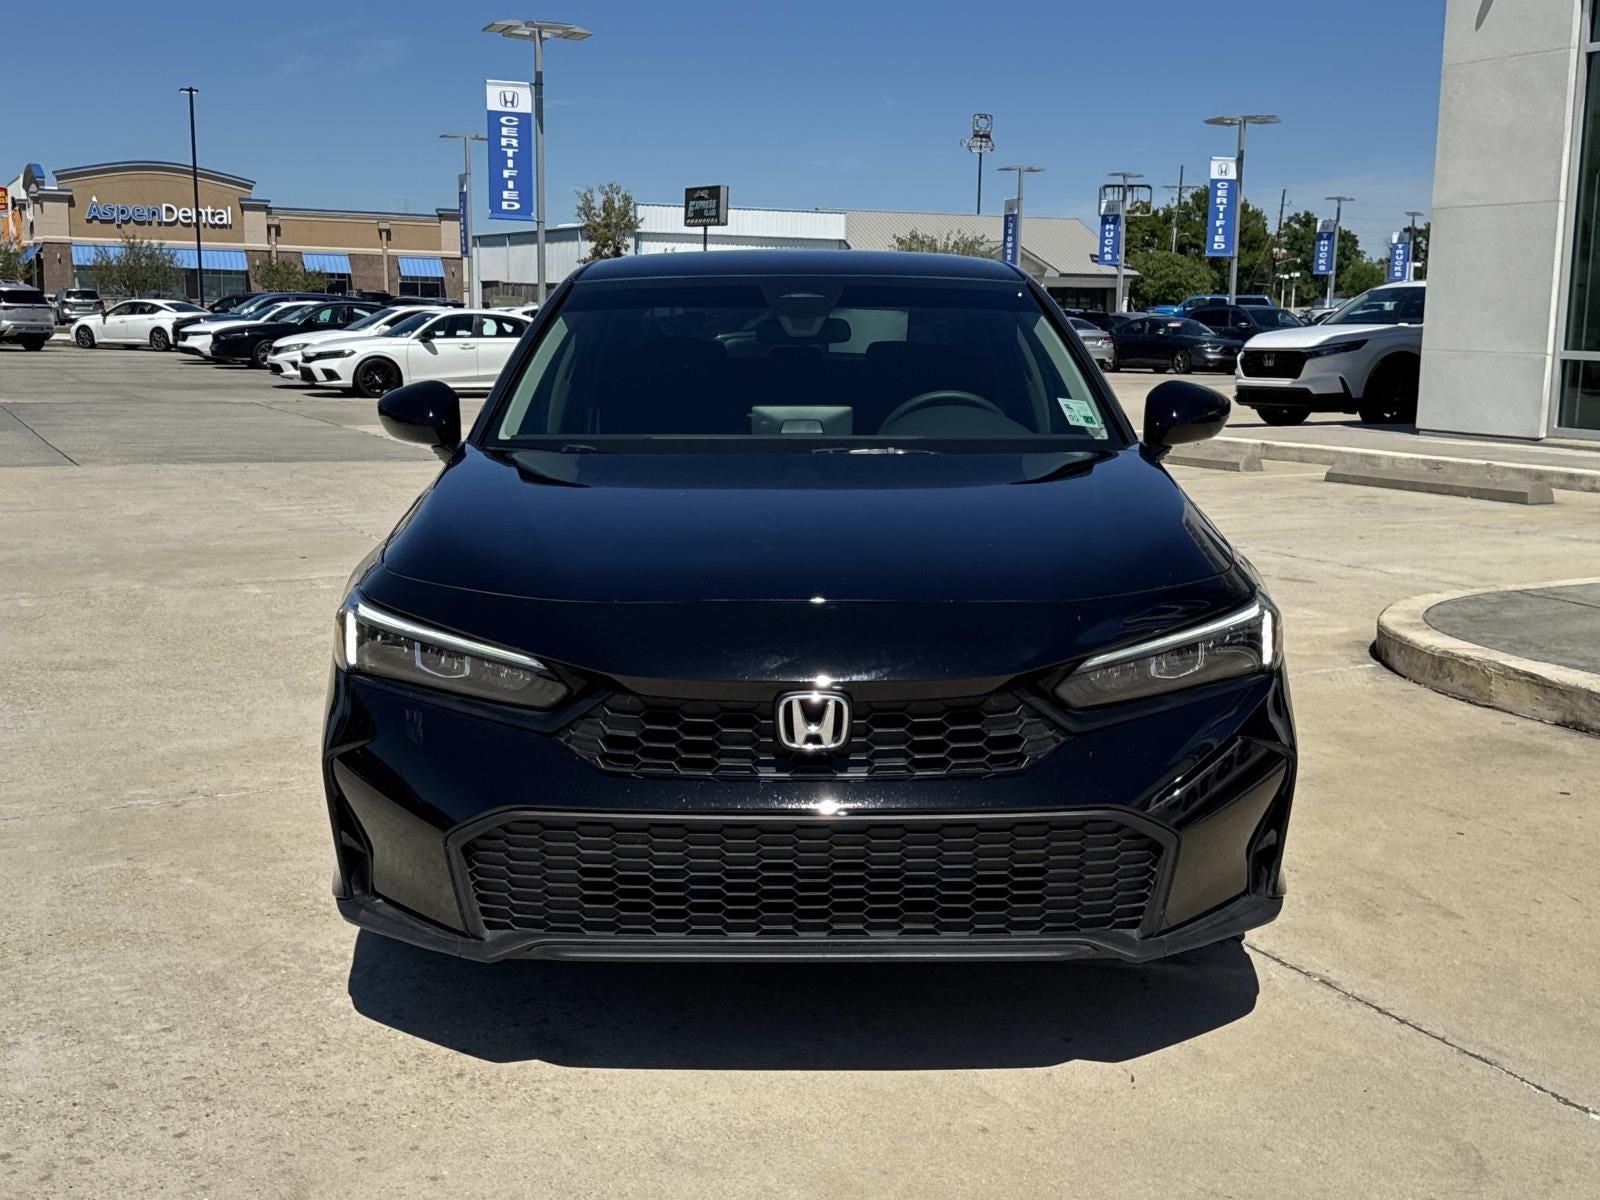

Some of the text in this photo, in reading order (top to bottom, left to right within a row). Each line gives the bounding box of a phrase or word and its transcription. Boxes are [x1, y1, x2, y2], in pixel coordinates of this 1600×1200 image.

[500, 116, 520, 211] CERTIFIED
[1104, 216, 1114, 260] TRUCKS
[1213, 182, 1229, 250] CERTIFIED
[1318, 233, 1328, 271] TRUCKS
